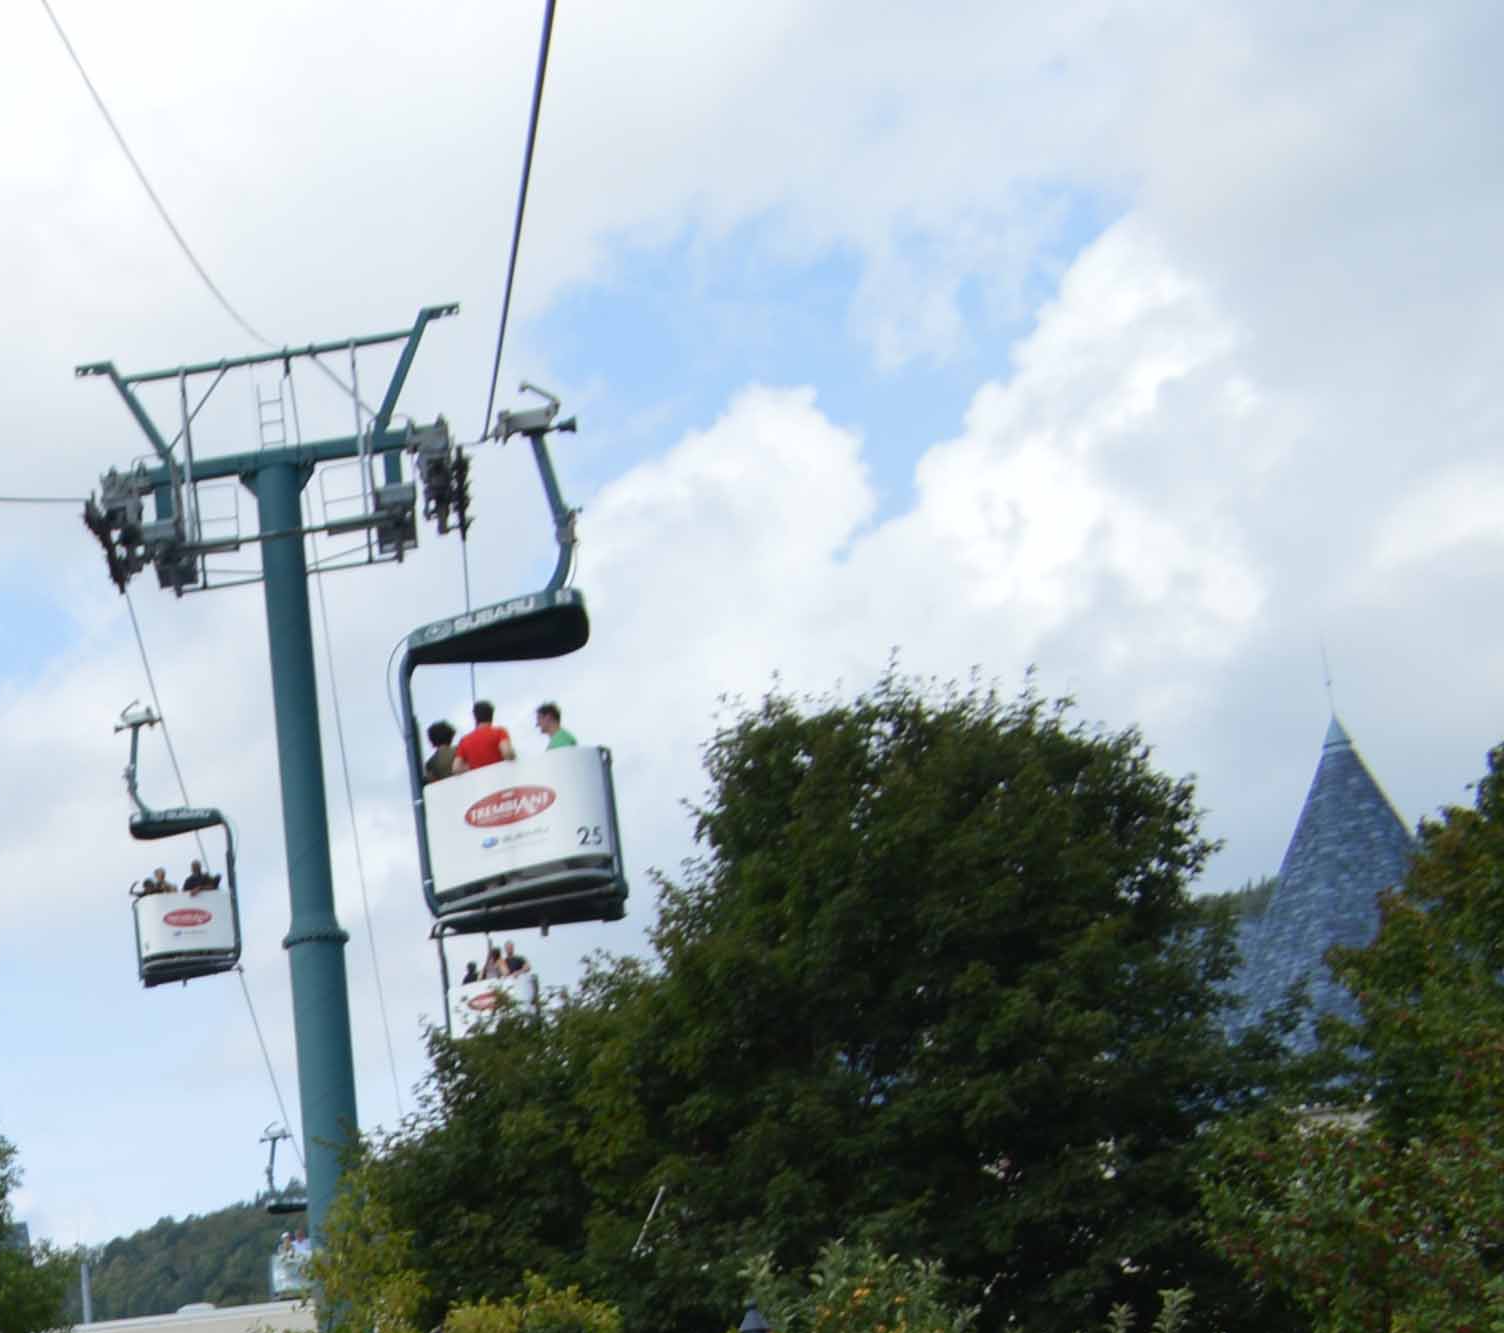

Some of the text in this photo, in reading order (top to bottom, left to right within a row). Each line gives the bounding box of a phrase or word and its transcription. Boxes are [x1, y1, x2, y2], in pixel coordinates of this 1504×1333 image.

[454, 596, 535, 630] SUBARU
[471, 791, 550, 821] TREMBLANT
[576, 825, 604, 846] 25
